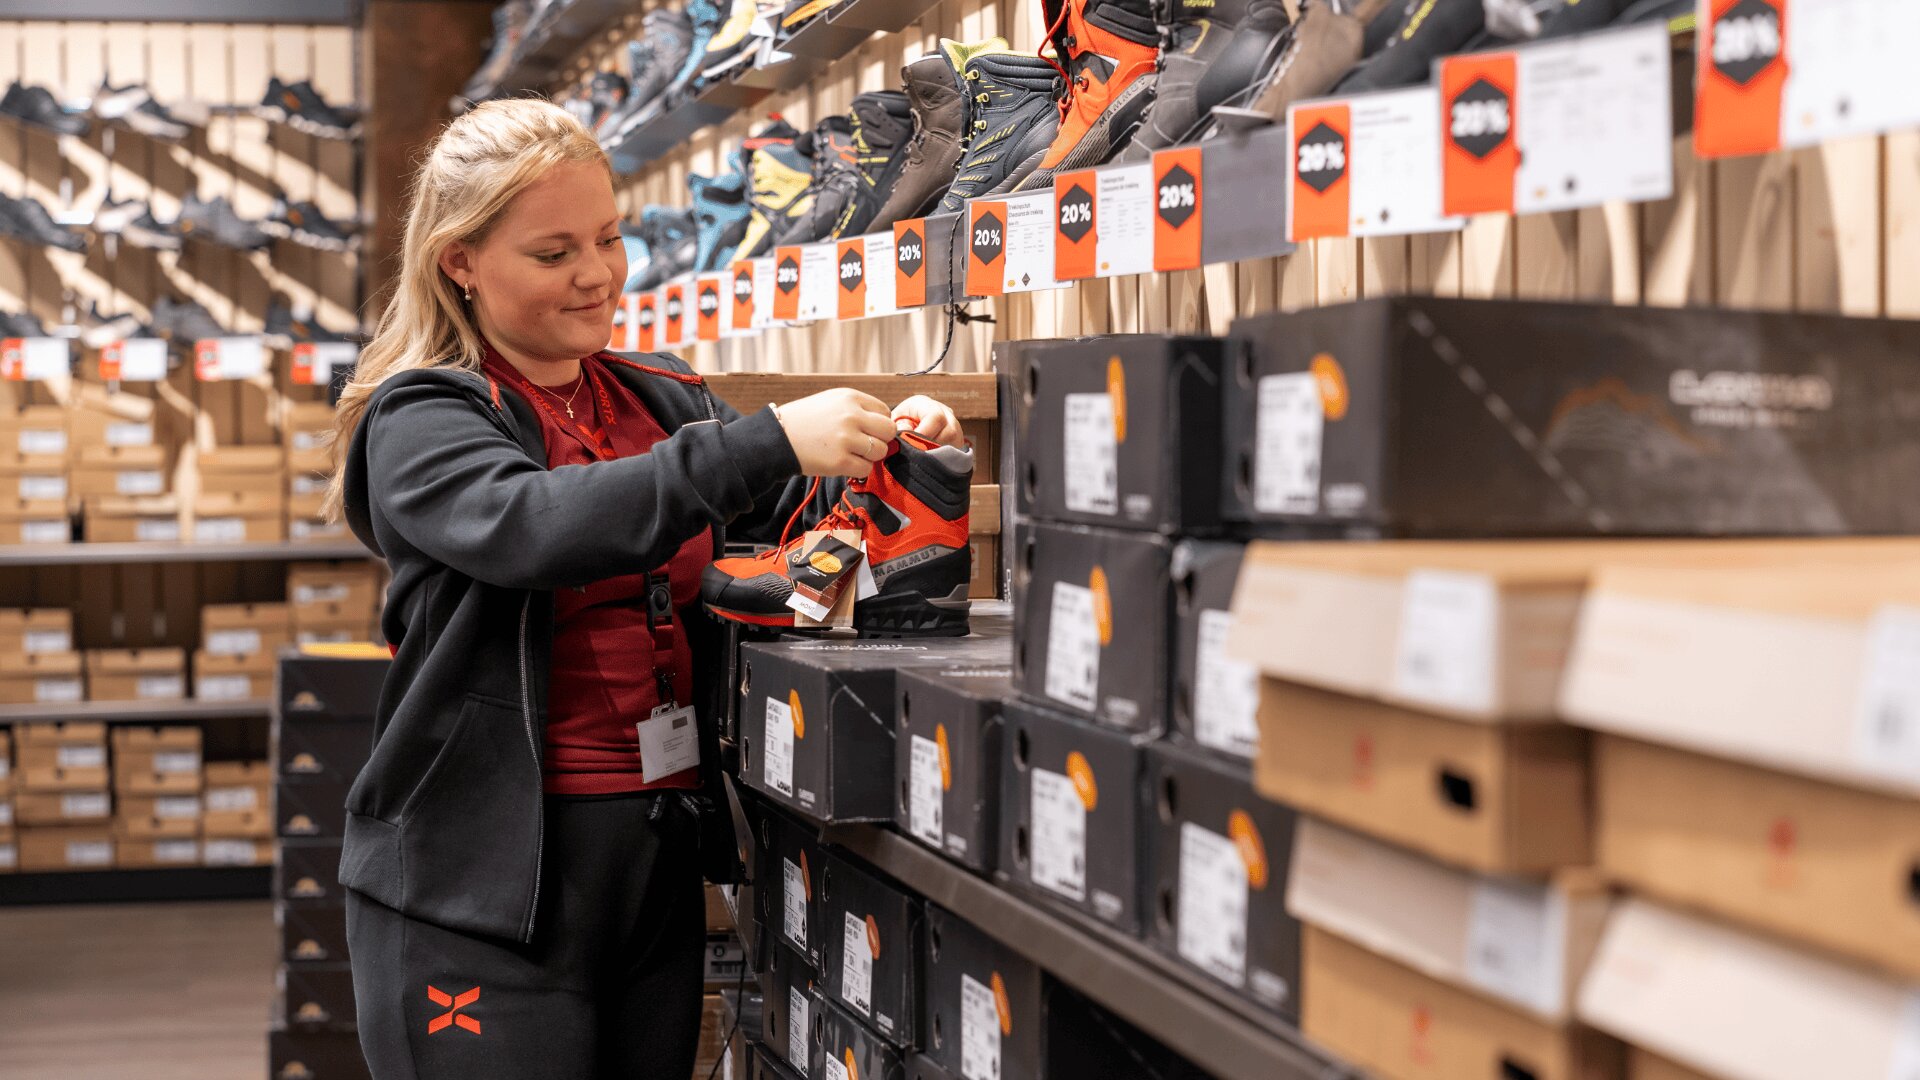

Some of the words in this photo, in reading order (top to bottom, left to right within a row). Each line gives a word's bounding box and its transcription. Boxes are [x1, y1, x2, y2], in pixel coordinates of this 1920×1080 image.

[1297, 140, 1346, 173] 20%
[1159, 183, 1195, 209] 20%
[1061, 202, 1092, 224] 20%
[974, 229, 1001, 246] 20%
[898, 244, 922, 261] 20%
[840, 261, 863, 279] 20%
[873, 547, 937, 579] MAMMUT
